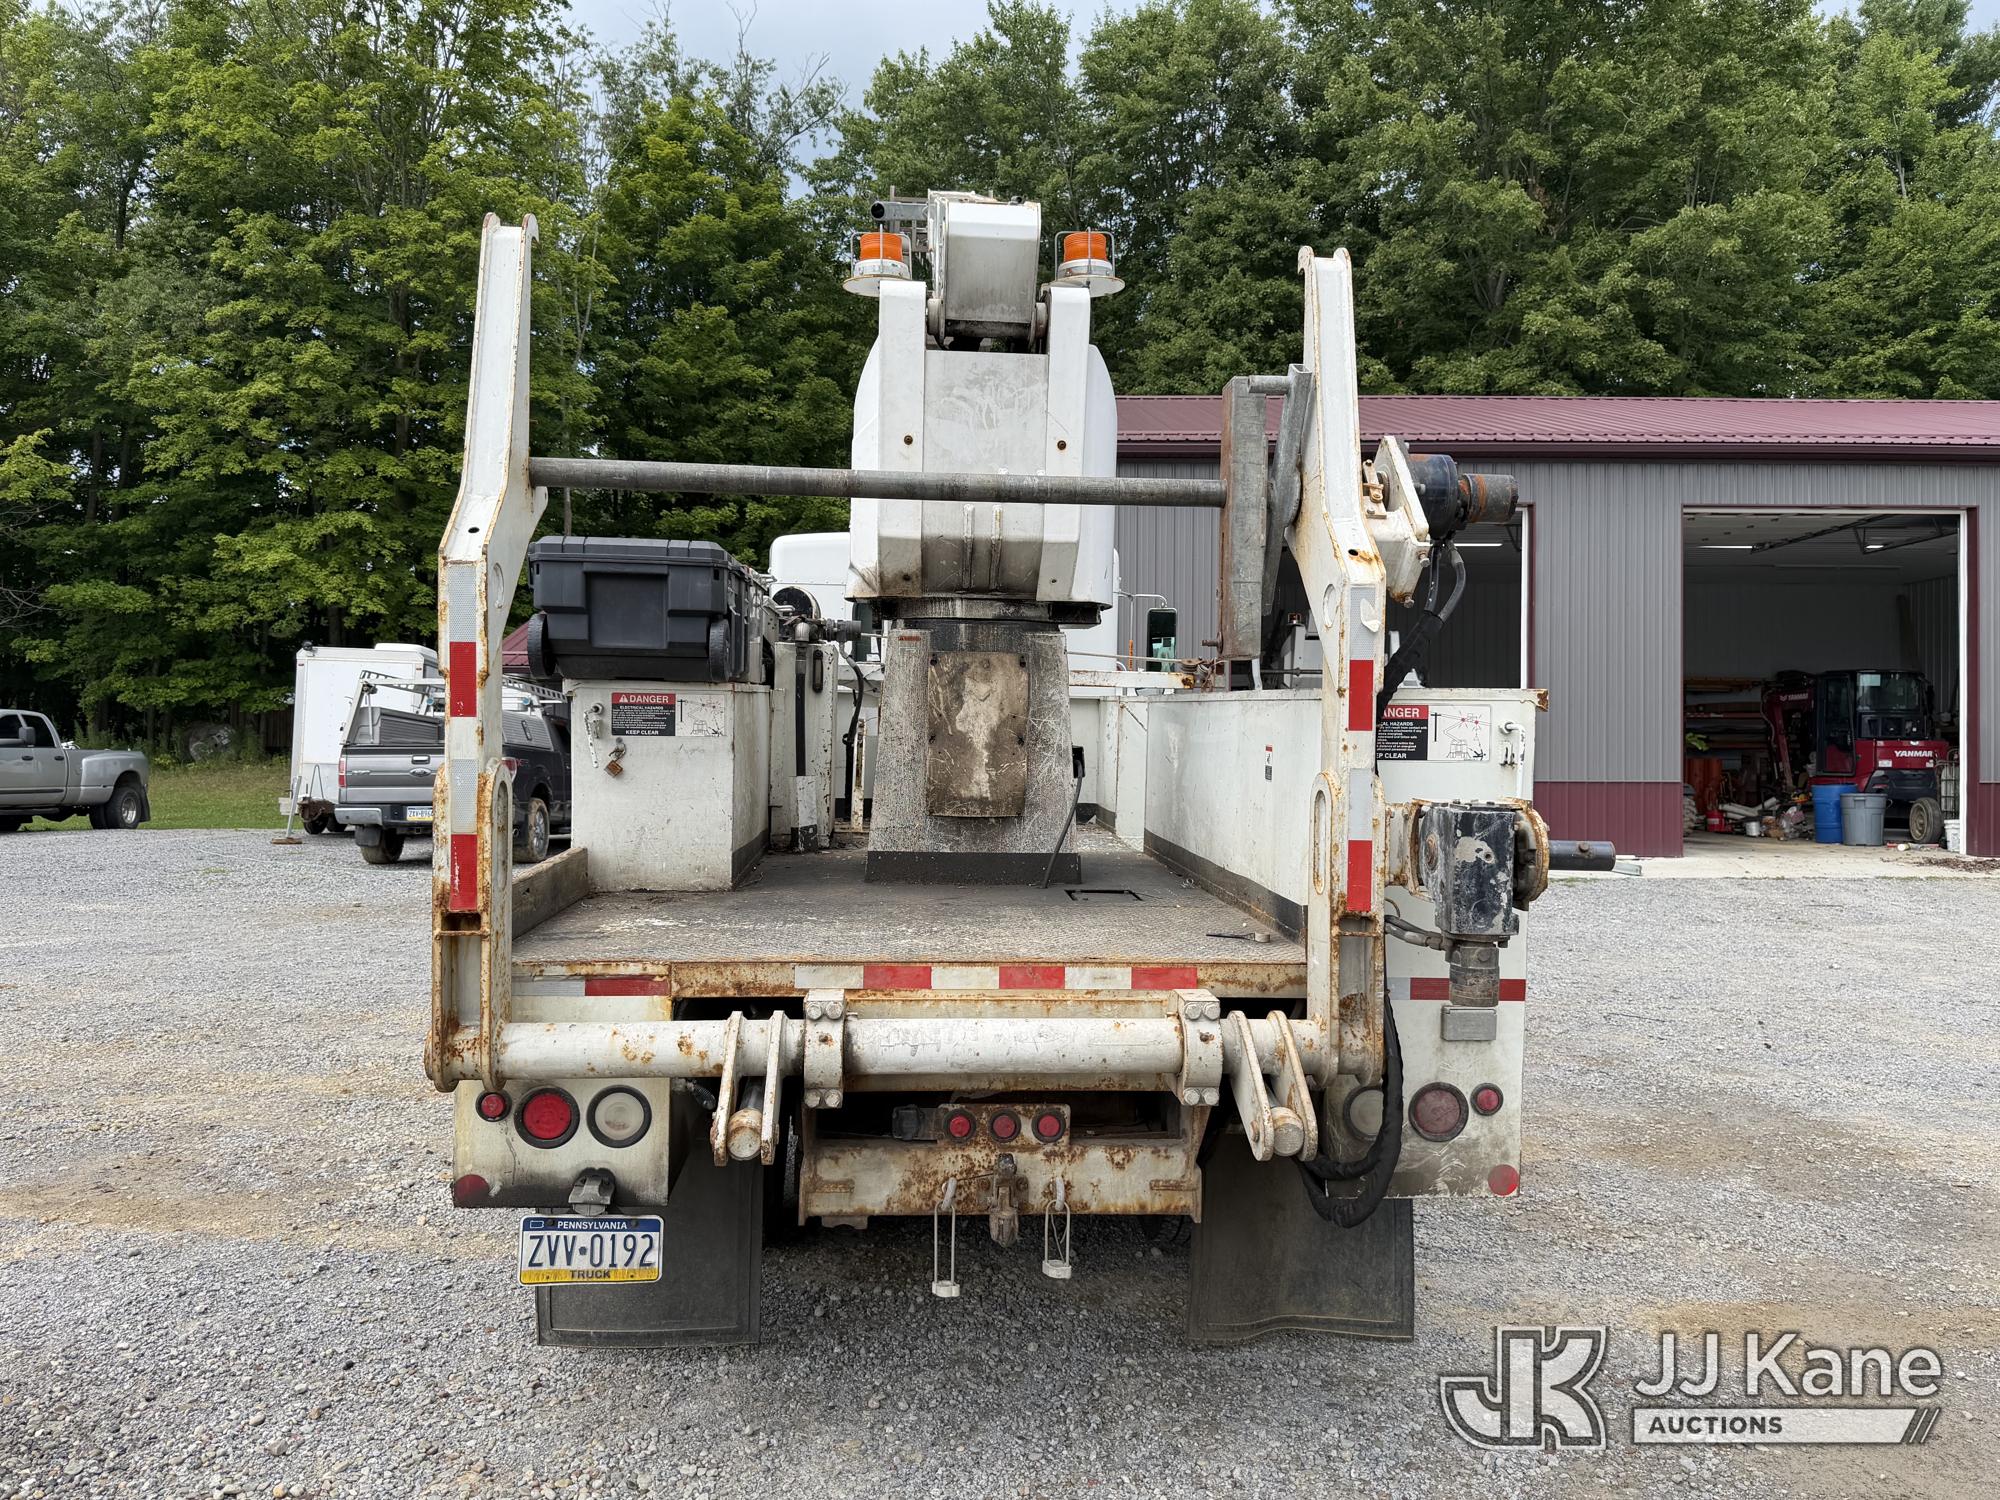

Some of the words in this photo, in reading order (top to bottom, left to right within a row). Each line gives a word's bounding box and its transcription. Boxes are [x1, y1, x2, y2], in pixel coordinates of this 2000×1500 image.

[629, 695, 669, 704] DANGER
[1894, 750, 1933, 758] YANMAR
[557, 1221, 628, 1230] PENNSYLVANIA
[570, 1269, 611, 1280] TRUCK
